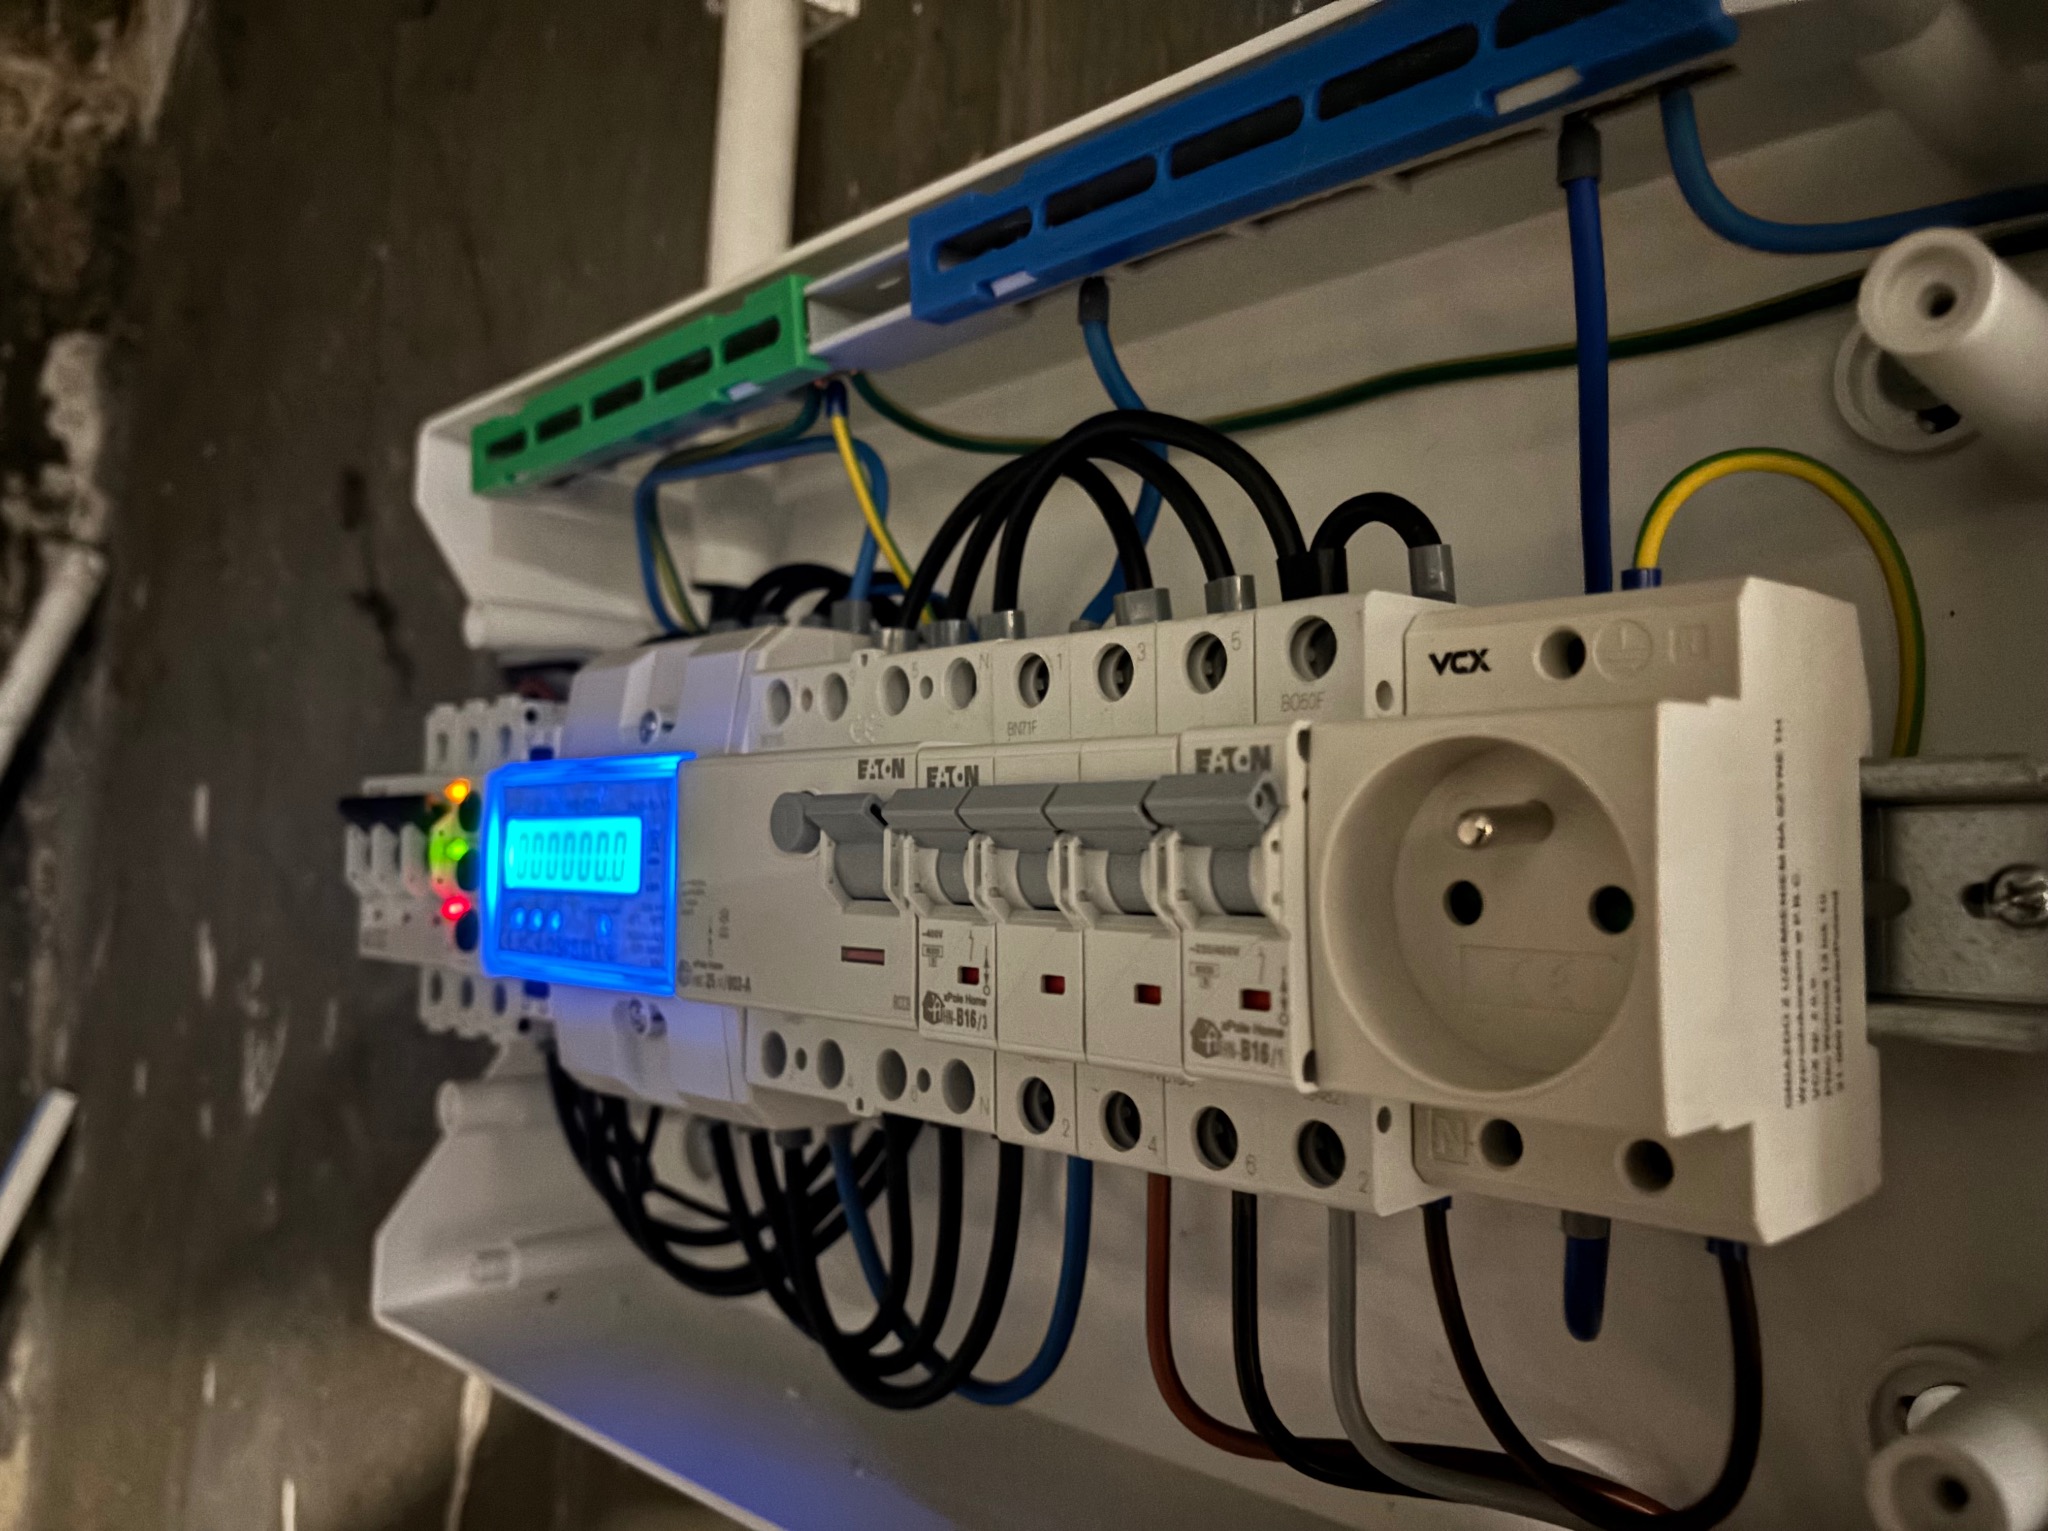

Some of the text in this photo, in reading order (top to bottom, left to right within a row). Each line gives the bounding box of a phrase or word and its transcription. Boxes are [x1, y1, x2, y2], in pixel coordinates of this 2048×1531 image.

[1231, 632, 1241, 650] 5
[1138, 643, 1146, 662] 3
[1429, 648, 1491, 675] VCX
[857, 758, 905, 780] EATON
[1195, 745, 1272, 774] EATON
[926, 765, 979, 788] EATON
[1061, 1118, 1070, 1137] 2
[1359, 1171, 1369, 1192] 2
